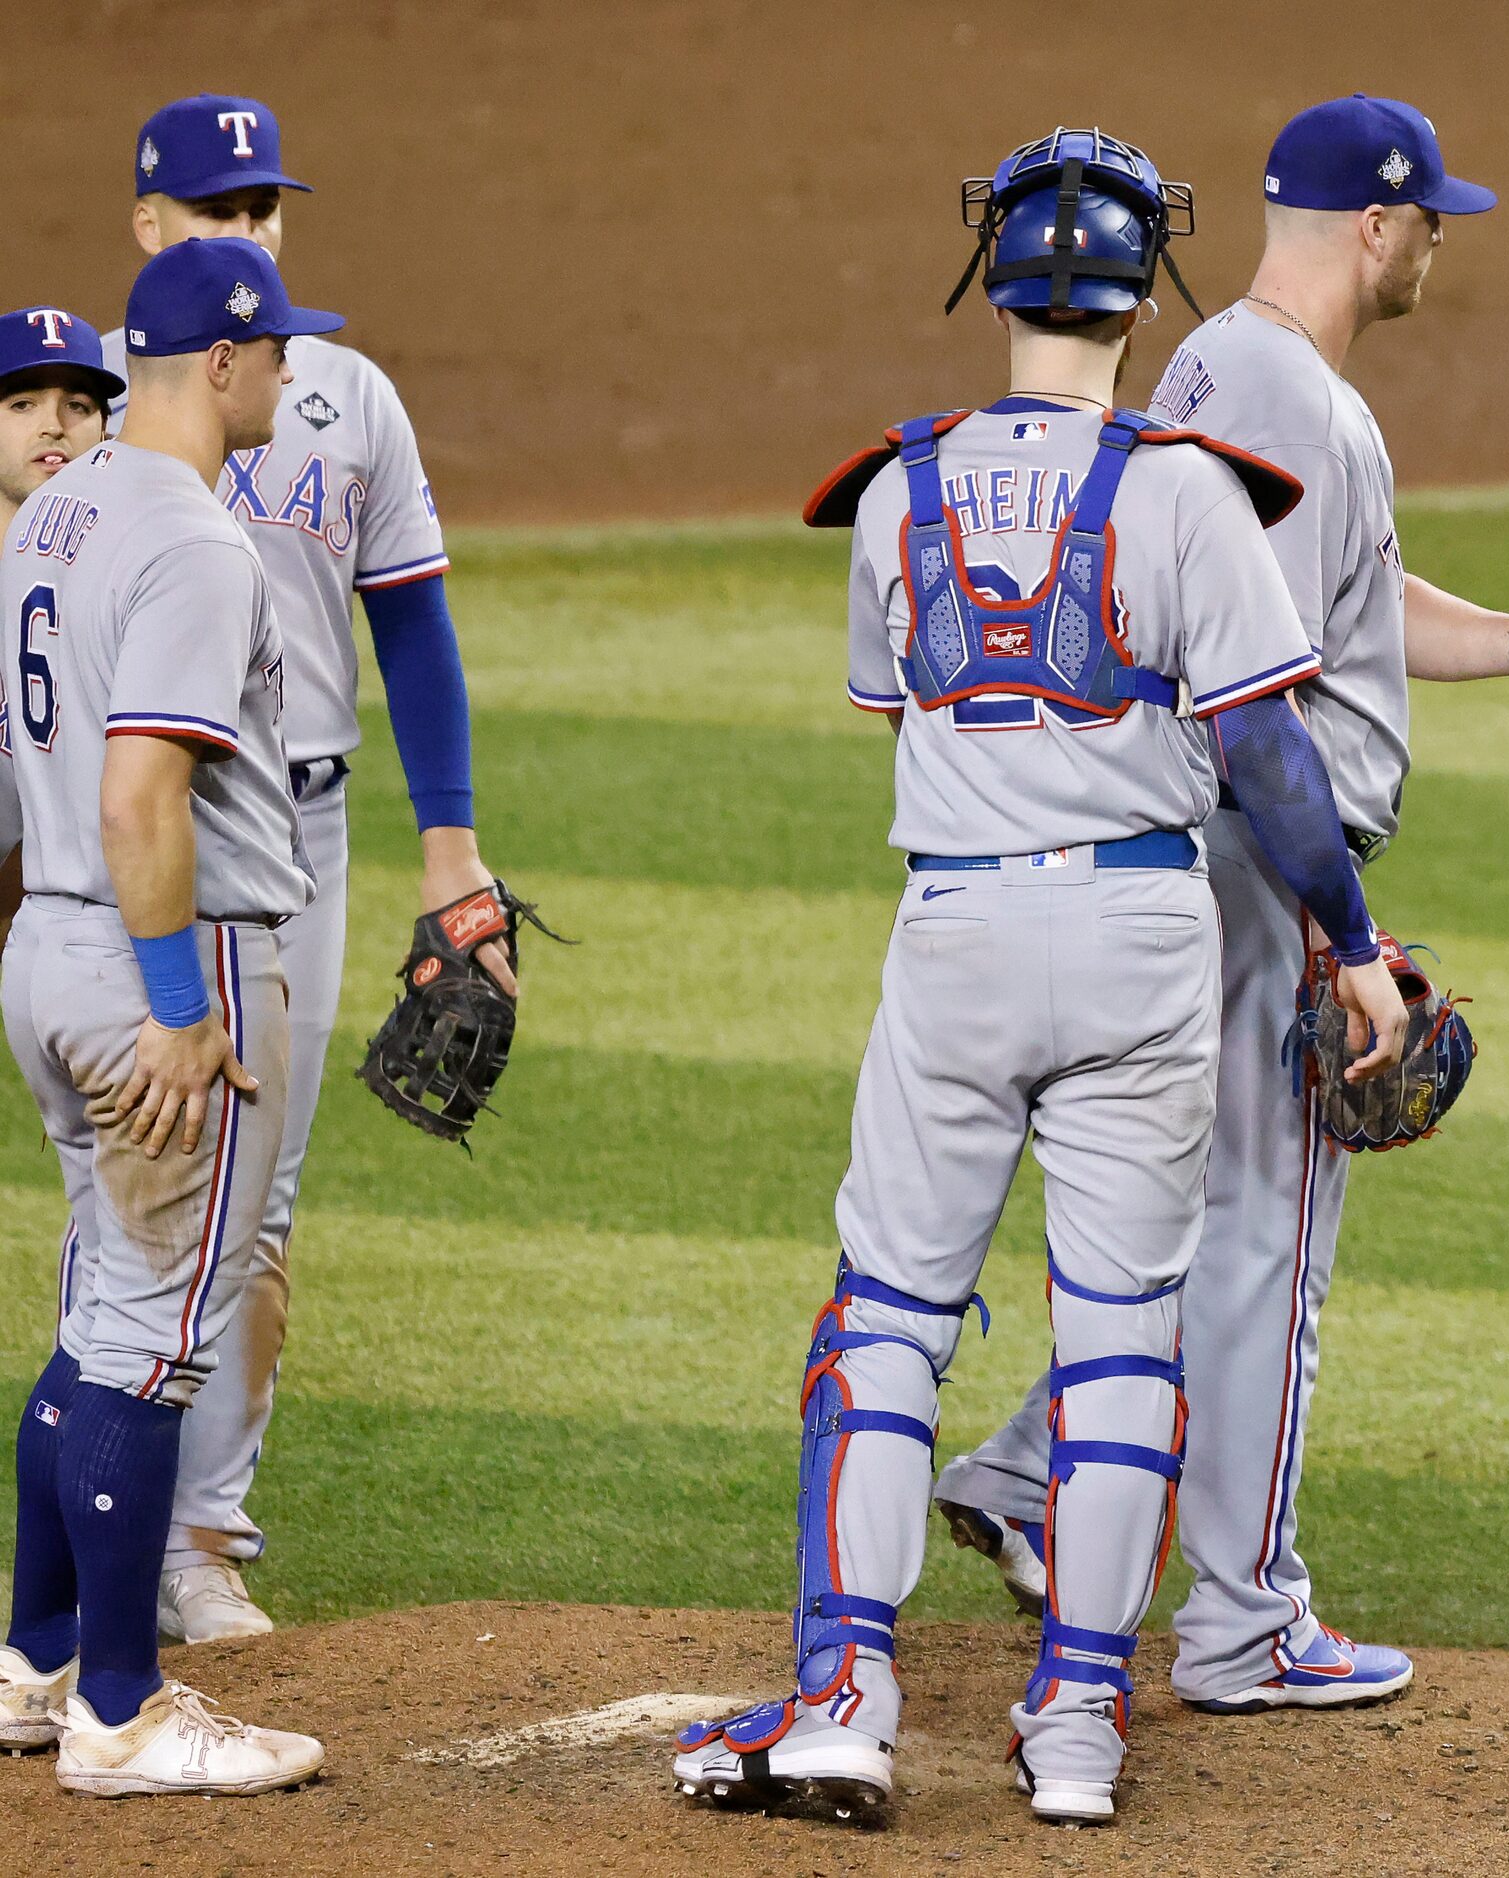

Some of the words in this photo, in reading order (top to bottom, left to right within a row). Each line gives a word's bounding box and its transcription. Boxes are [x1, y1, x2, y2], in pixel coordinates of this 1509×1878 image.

[218, 111, 259, 158] T
[27, 309, 72, 349] T
[1150, 345, 1217, 425] MITH
[16, 493, 101, 566] JUNG
[18, 580, 61, 754] 6
